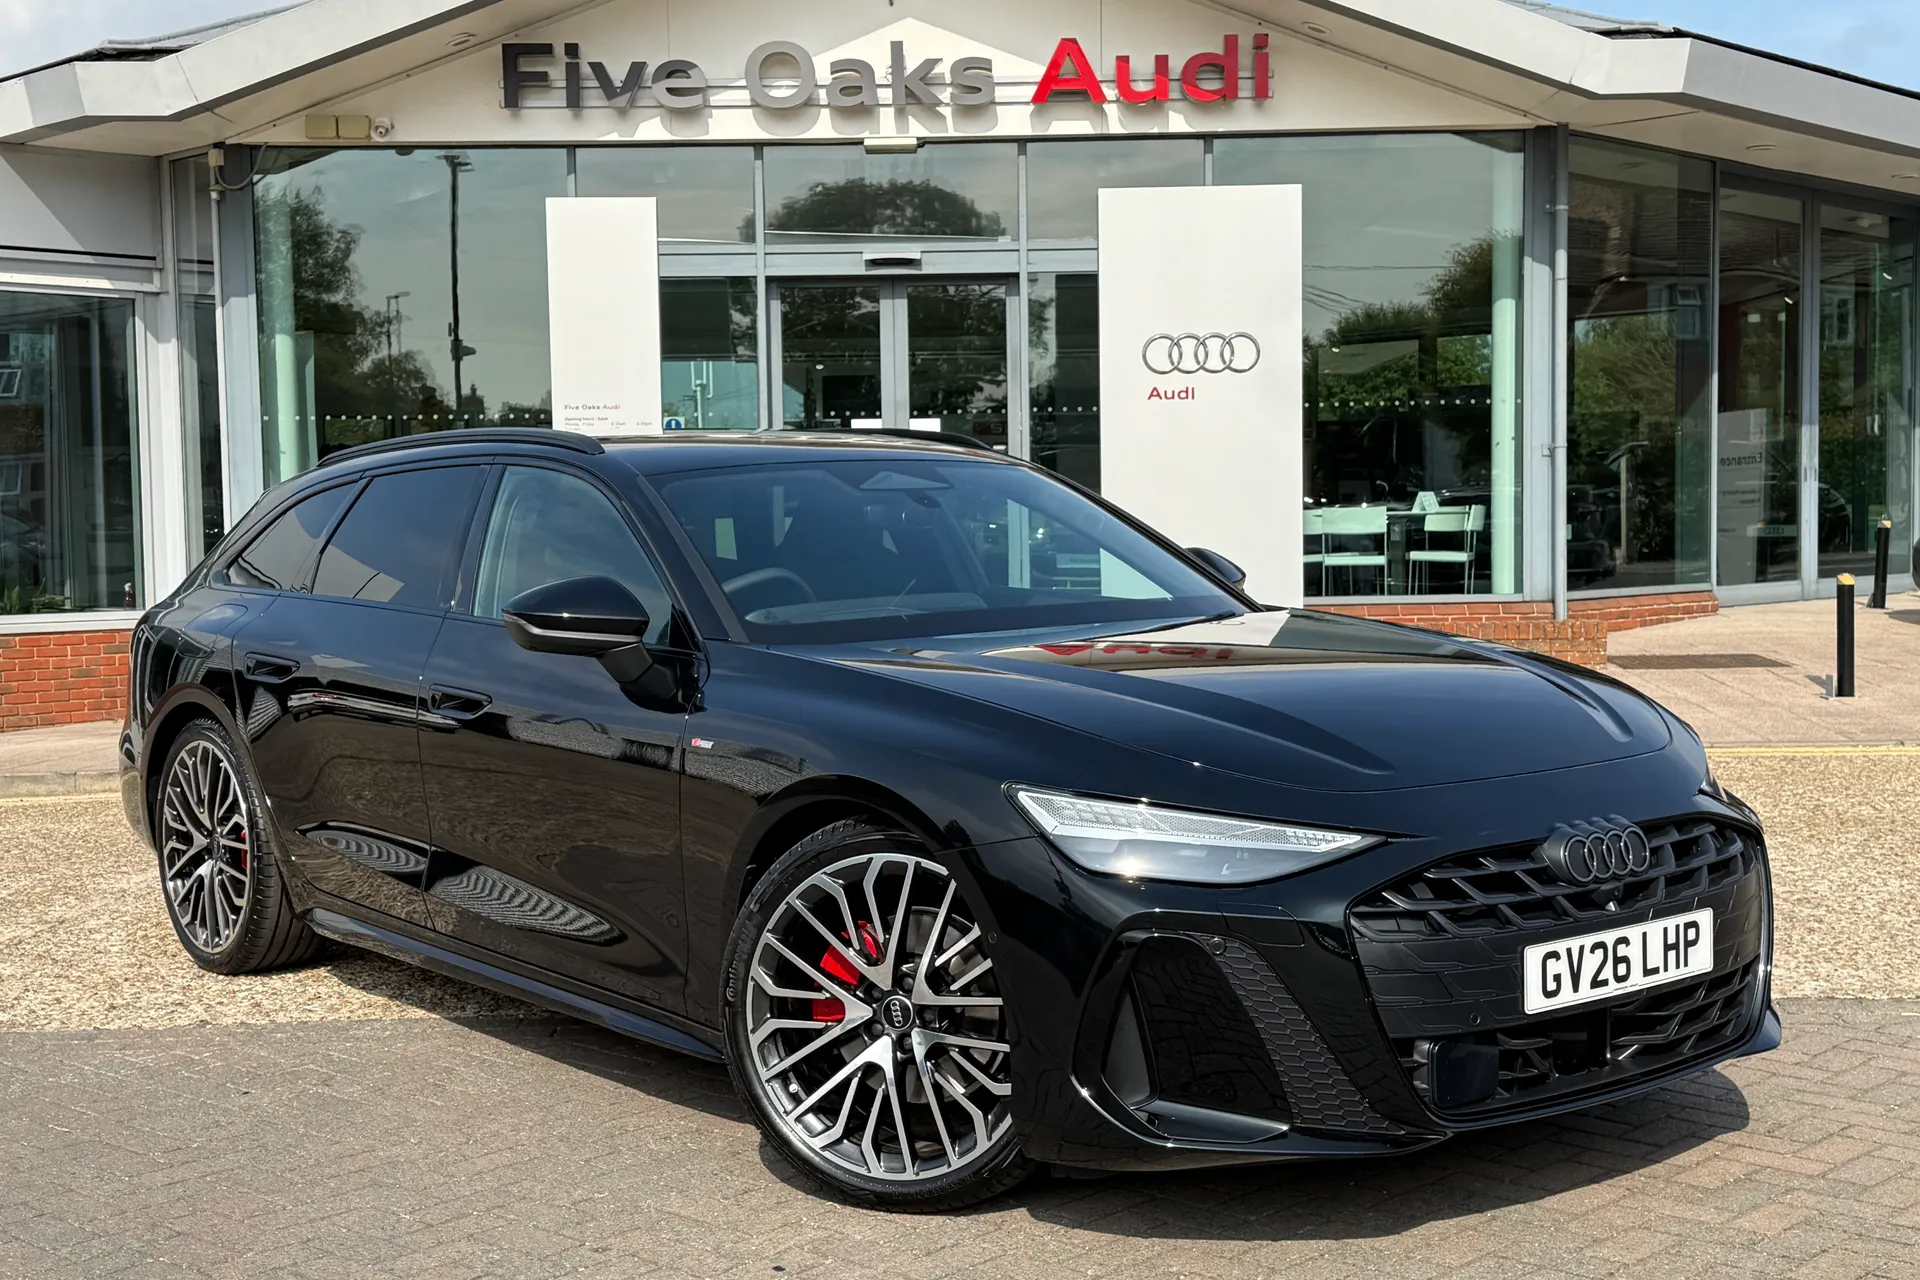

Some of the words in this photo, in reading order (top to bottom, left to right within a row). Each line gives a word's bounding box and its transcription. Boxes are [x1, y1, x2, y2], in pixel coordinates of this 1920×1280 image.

[502, 43, 707, 110] Five
[744, 40, 995, 109] Oaks
[1030, 33, 1269, 105] Audi
[581, 403, 601, 411] Oaks
[1147, 386, 1196, 401] Audi
[1541, 936, 1631, 999] GV26
[1641, 920, 1700, 978] LHP
